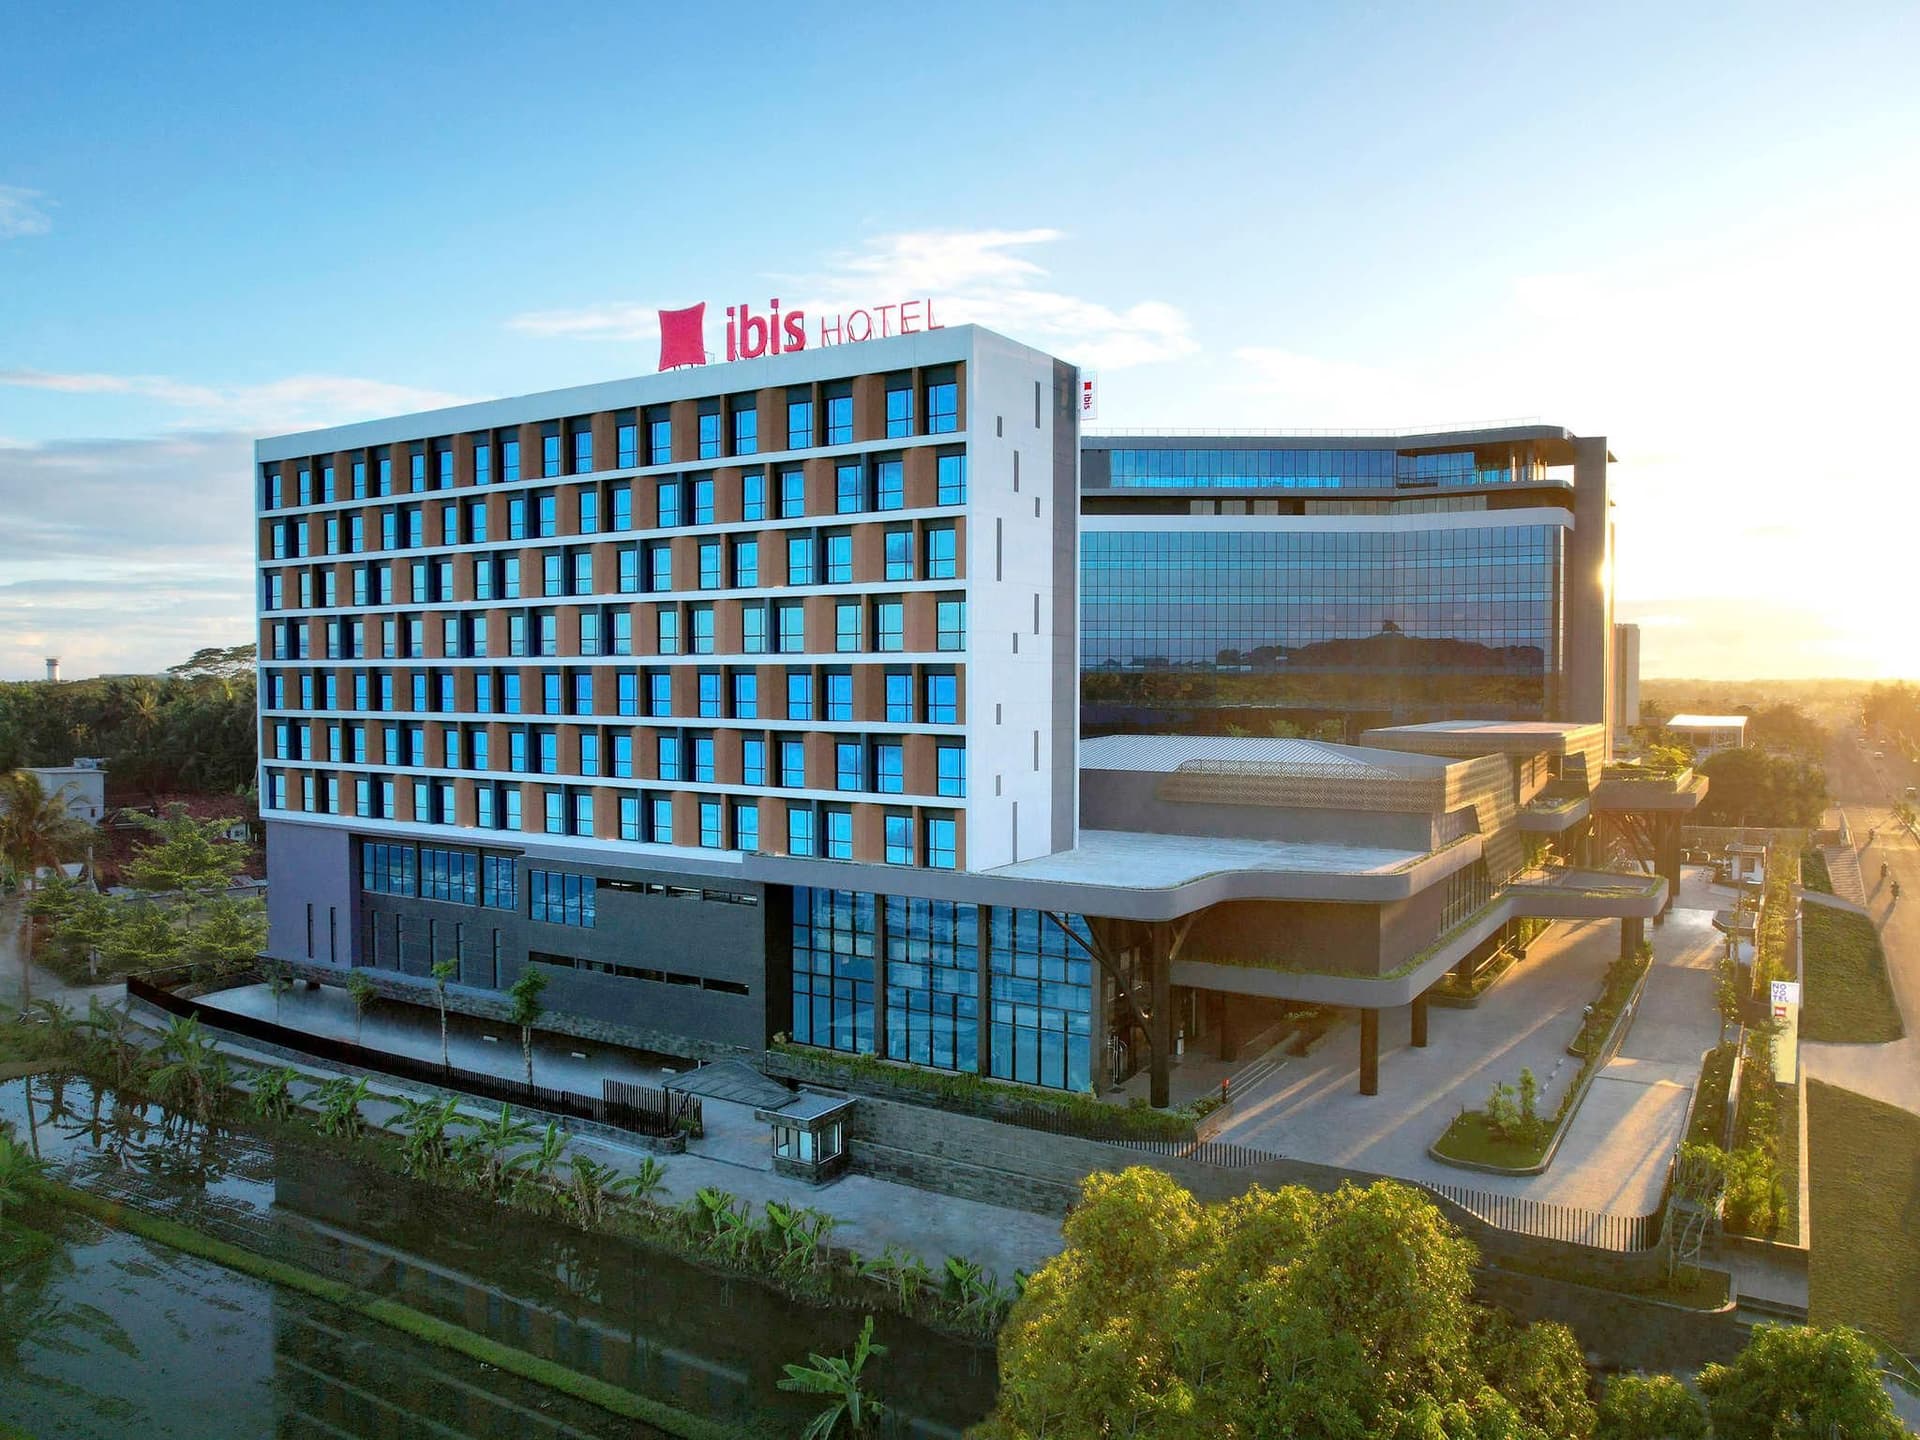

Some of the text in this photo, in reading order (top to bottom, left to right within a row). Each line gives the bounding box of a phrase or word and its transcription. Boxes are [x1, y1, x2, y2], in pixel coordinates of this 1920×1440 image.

[726, 297, 945, 362] ibis HOTEL
[1083, 393, 1092, 410] ibis
